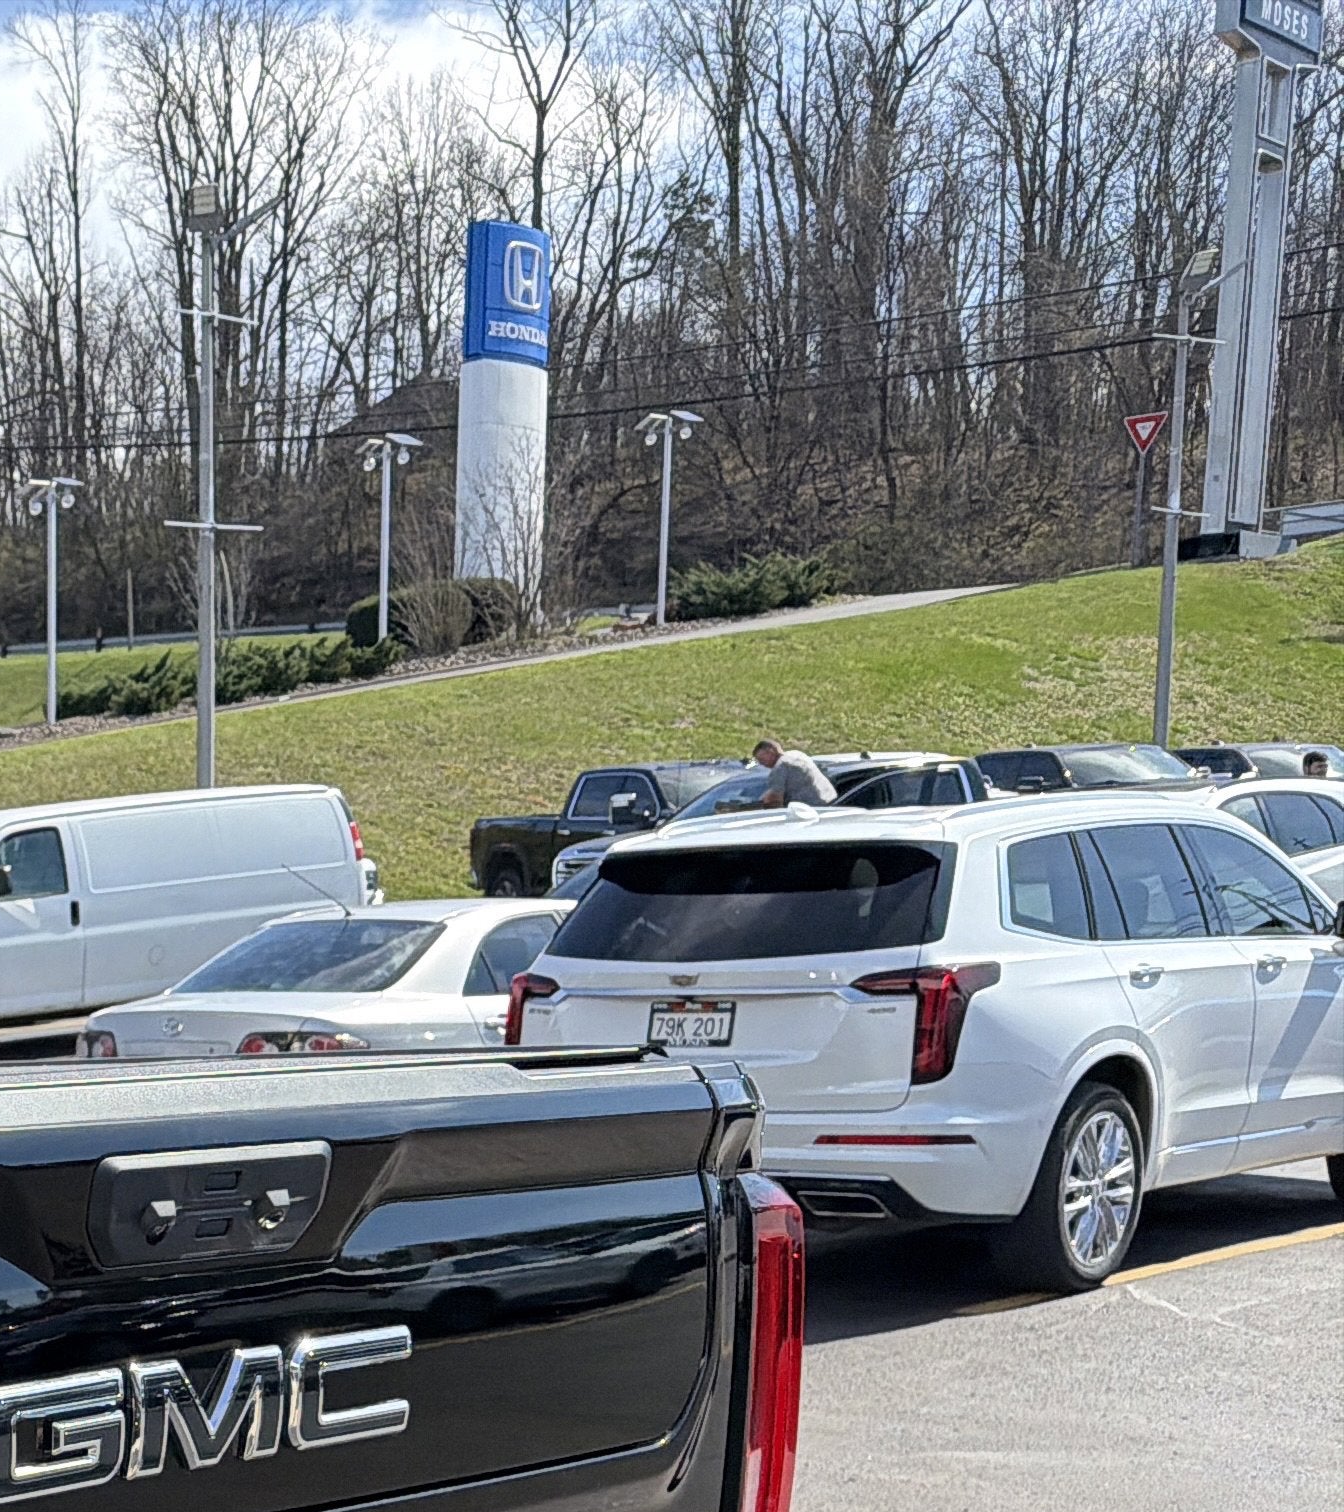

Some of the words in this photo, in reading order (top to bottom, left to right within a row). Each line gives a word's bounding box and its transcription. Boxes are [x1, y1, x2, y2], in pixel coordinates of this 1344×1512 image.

[1261, 0, 1308, 40] MOSES
[488, 320, 548, 347] HONDA
[656, 1017, 687, 1037] 79K
[693, 1017, 724, 1037] 201
